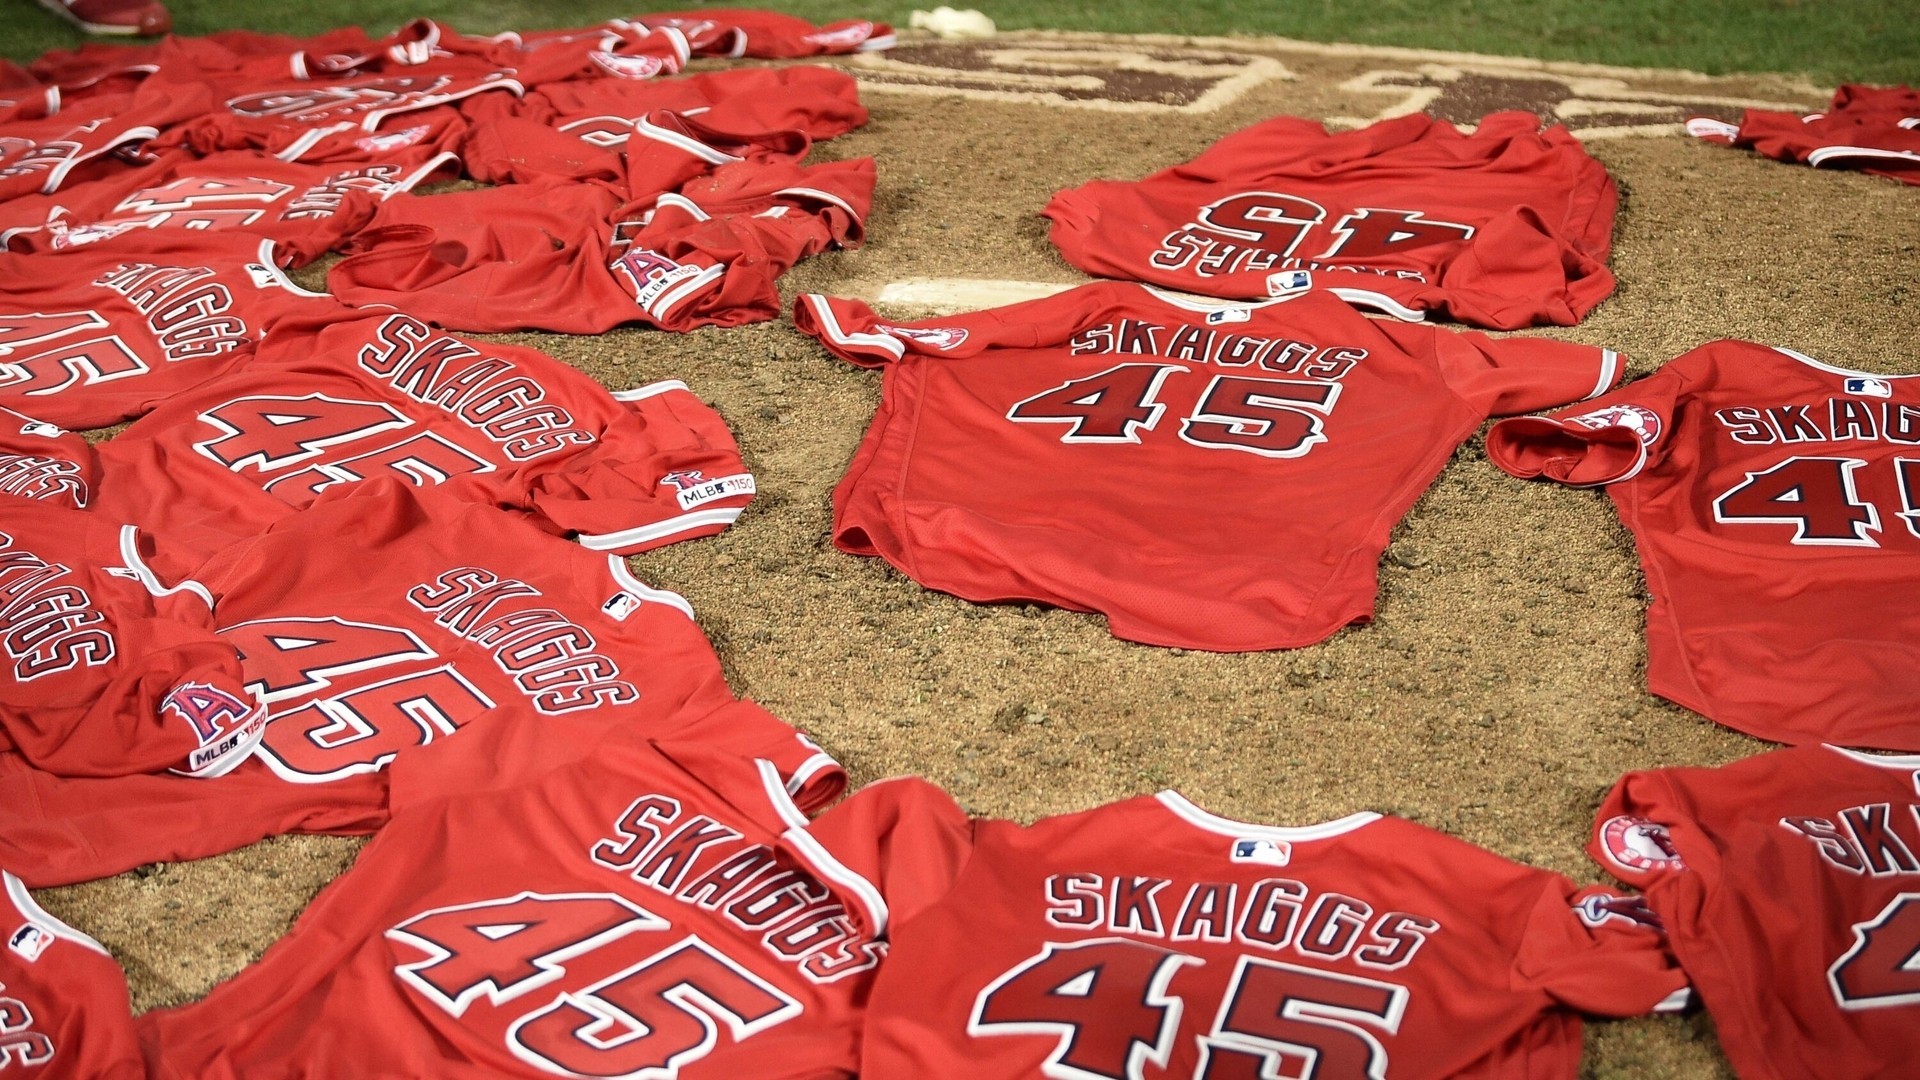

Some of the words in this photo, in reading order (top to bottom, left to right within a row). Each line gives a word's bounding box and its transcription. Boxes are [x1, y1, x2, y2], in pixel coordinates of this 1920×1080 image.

[91, 263, 253, 362] SKAGGS
[1071, 319, 1368, 380] SKAGGS
[357, 313, 600, 462] SKAGGS
[1005, 362, 1344, 459] 45
[192, 391, 499, 510] 45
[683, 485, 716, 505] MLB
[214, 615, 499, 785] 45
[406, 566, 641, 717] SKAGGS
[196, 741, 230, 766] MLB
[590, 793, 890, 985] SKAGGS
[1044, 872, 1442, 972] SKAGGS
[384, 890, 805, 1080] 45
[966, 936, 1411, 1080] 45
